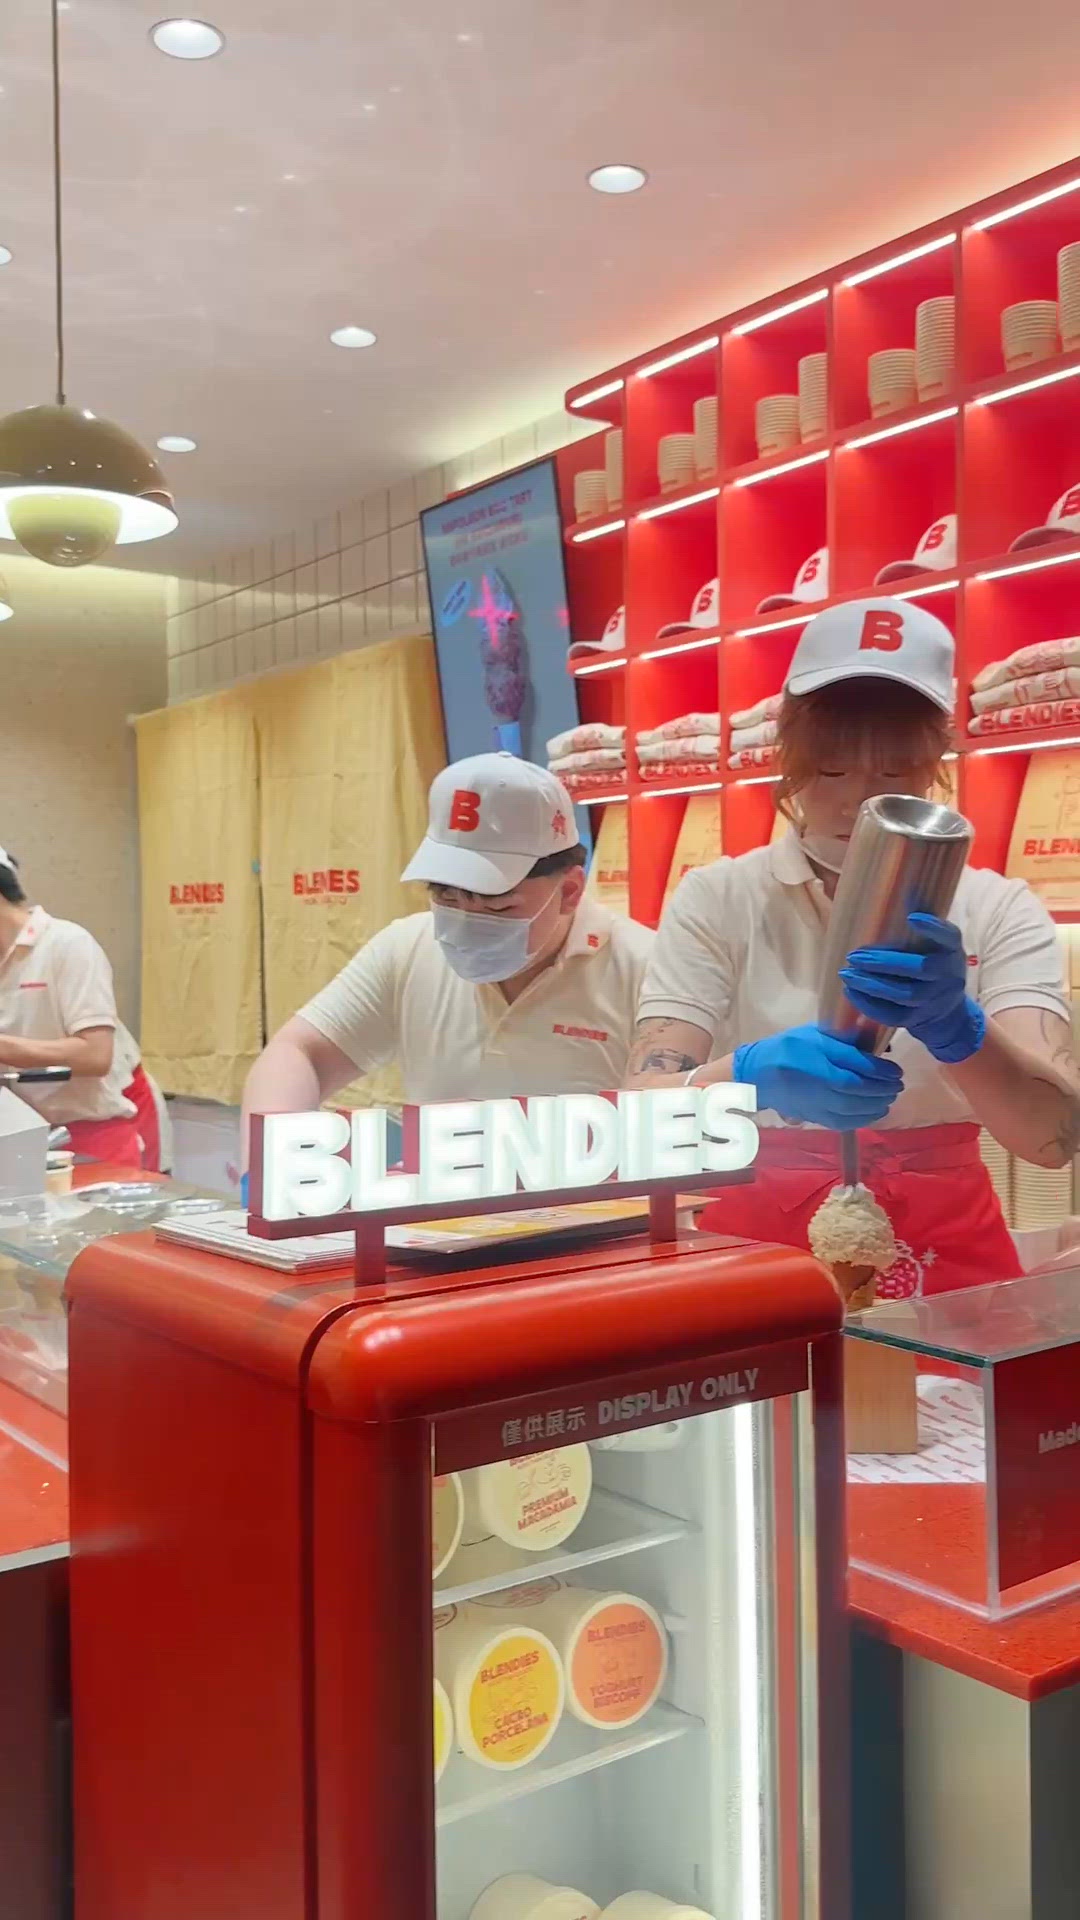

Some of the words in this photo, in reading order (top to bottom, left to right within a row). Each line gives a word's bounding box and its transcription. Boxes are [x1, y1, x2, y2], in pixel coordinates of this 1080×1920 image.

[922, 523, 948, 552] B
[858, 609, 904, 652] B
[448, 789, 481, 833] B
[262, 1083, 760, 1221] BLENDIES
[502, 1405, 586, 1448] 僅供展示
[597, 1381, 694, 1425] DISPLAY
[701, 1368, 759, 1400] ONLY
[517, 1495, 577, 1531] MACADAMIA
[522, 1487, 569, 1516] PREMIUM
[587, 1620, 646, 1642] BLENDIES
[480, 1650, 540, 1684] BLENDIES
